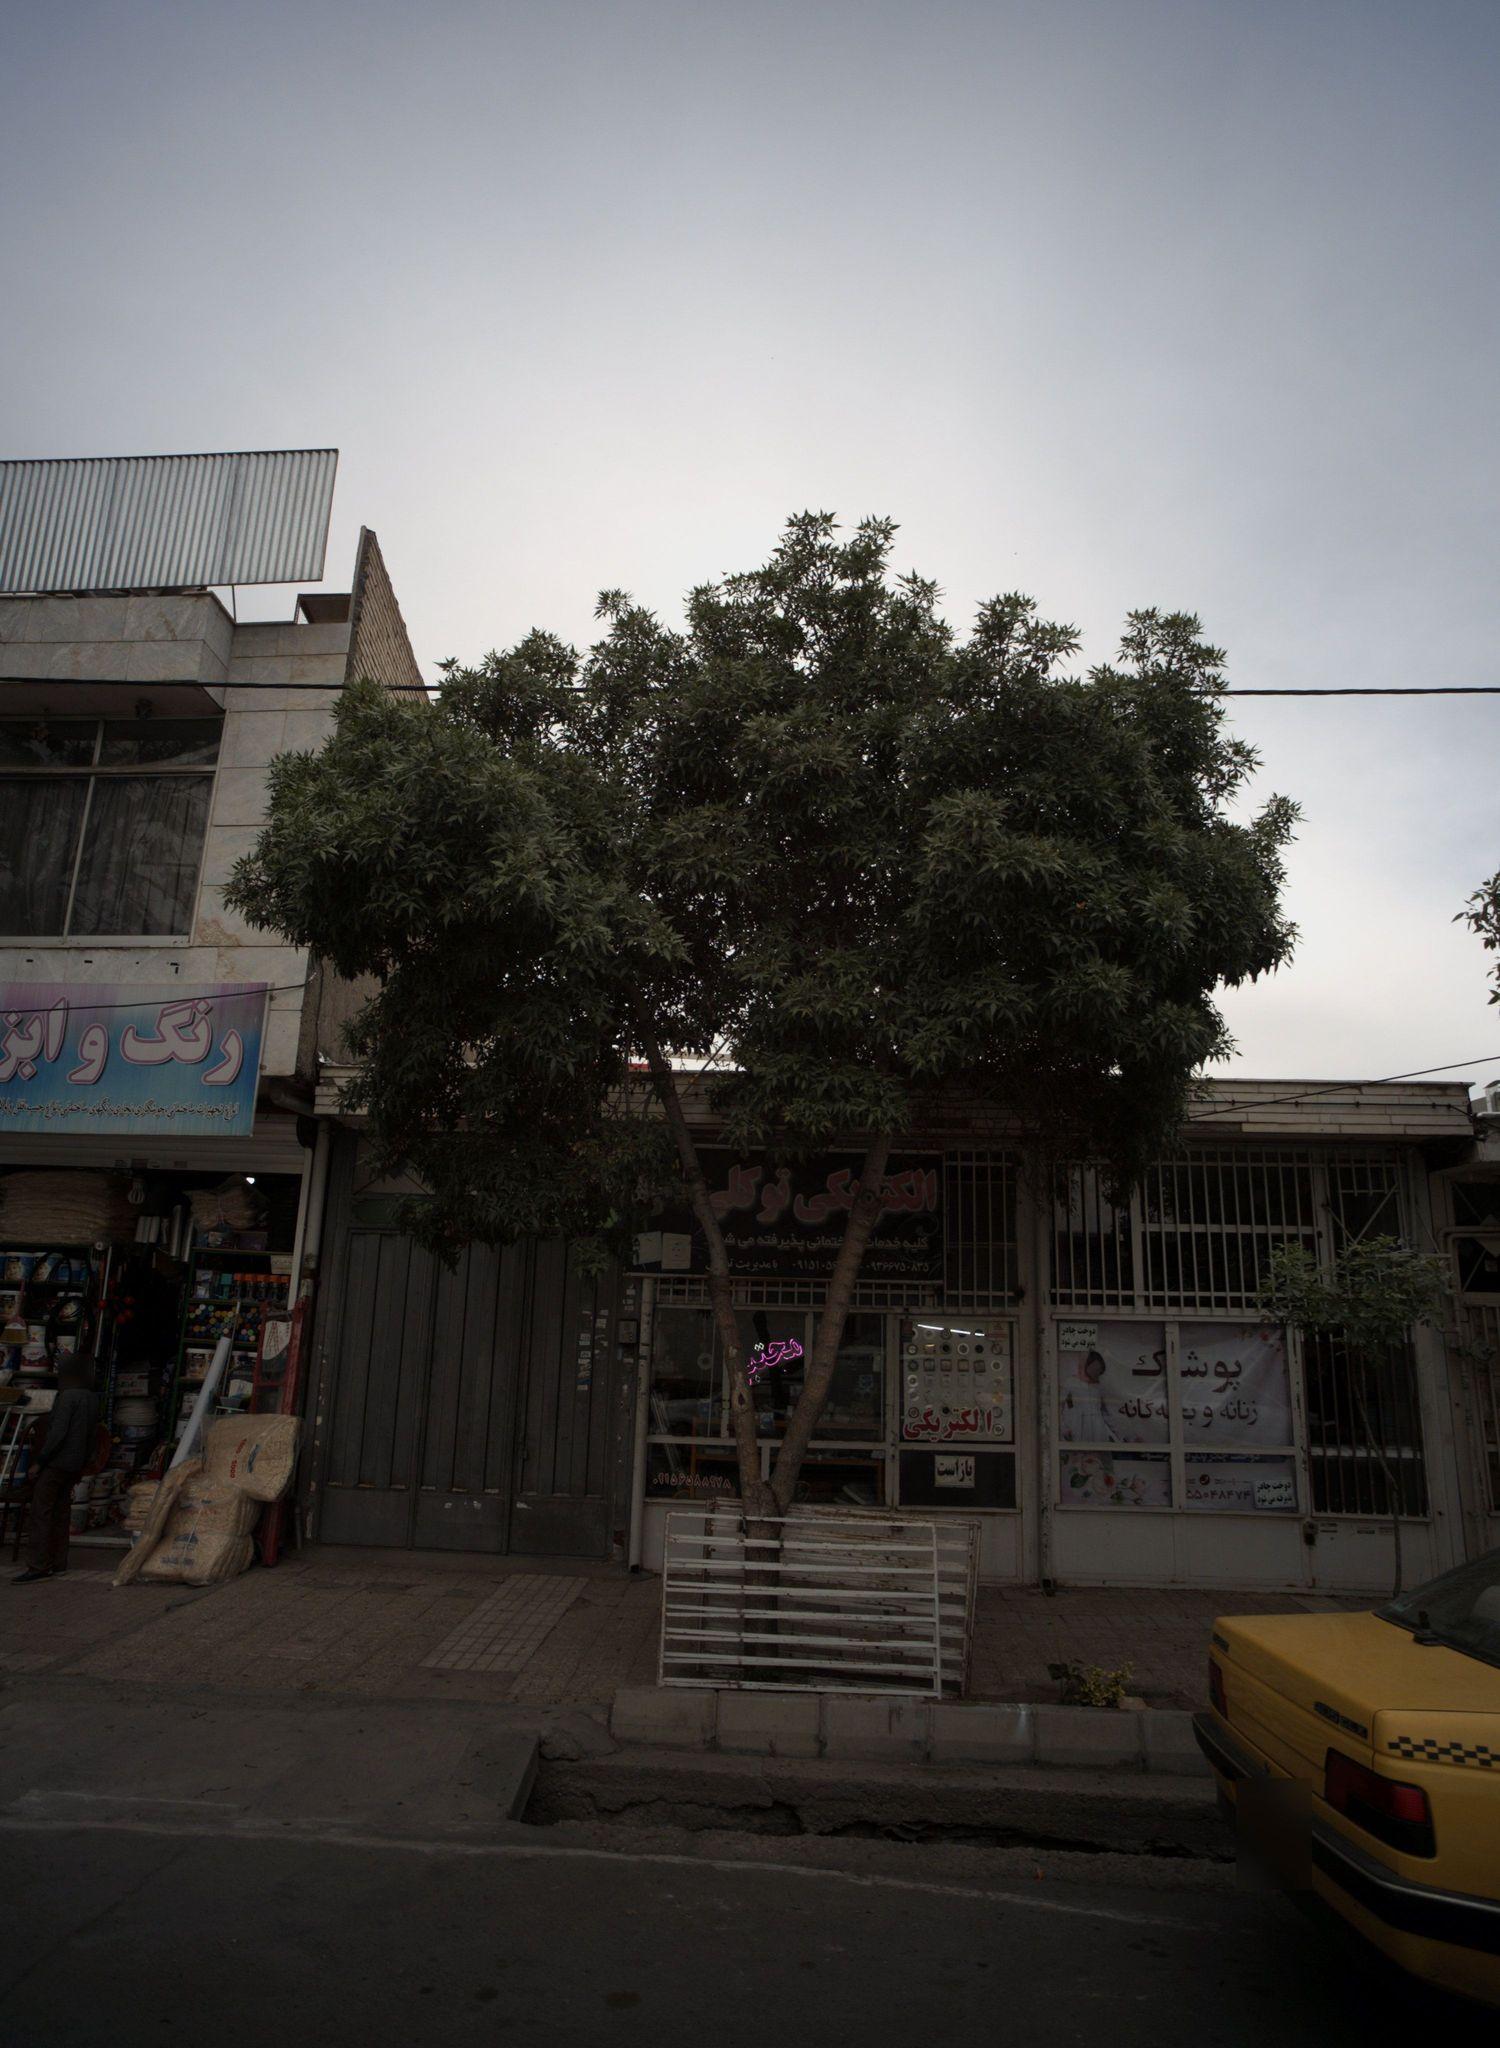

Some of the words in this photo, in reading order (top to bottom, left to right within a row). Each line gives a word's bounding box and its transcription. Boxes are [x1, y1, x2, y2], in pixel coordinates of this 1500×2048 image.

[67, 1024, 108, 1084] و
[120, 998, 244, 1086] رنگ
[756, 1233, 805, 1248] پذیرفته
[1132, 1350, 1242, 1393] پوشک
[904, 1408, 992, 1441] الکتریکی
[1201, 1405, 1213, 1428] و
[1220, 1398, 1258, 1426] زنانه
[937, 1459, 959, 1476] است
[958, 1459, 973, 1482] باز
